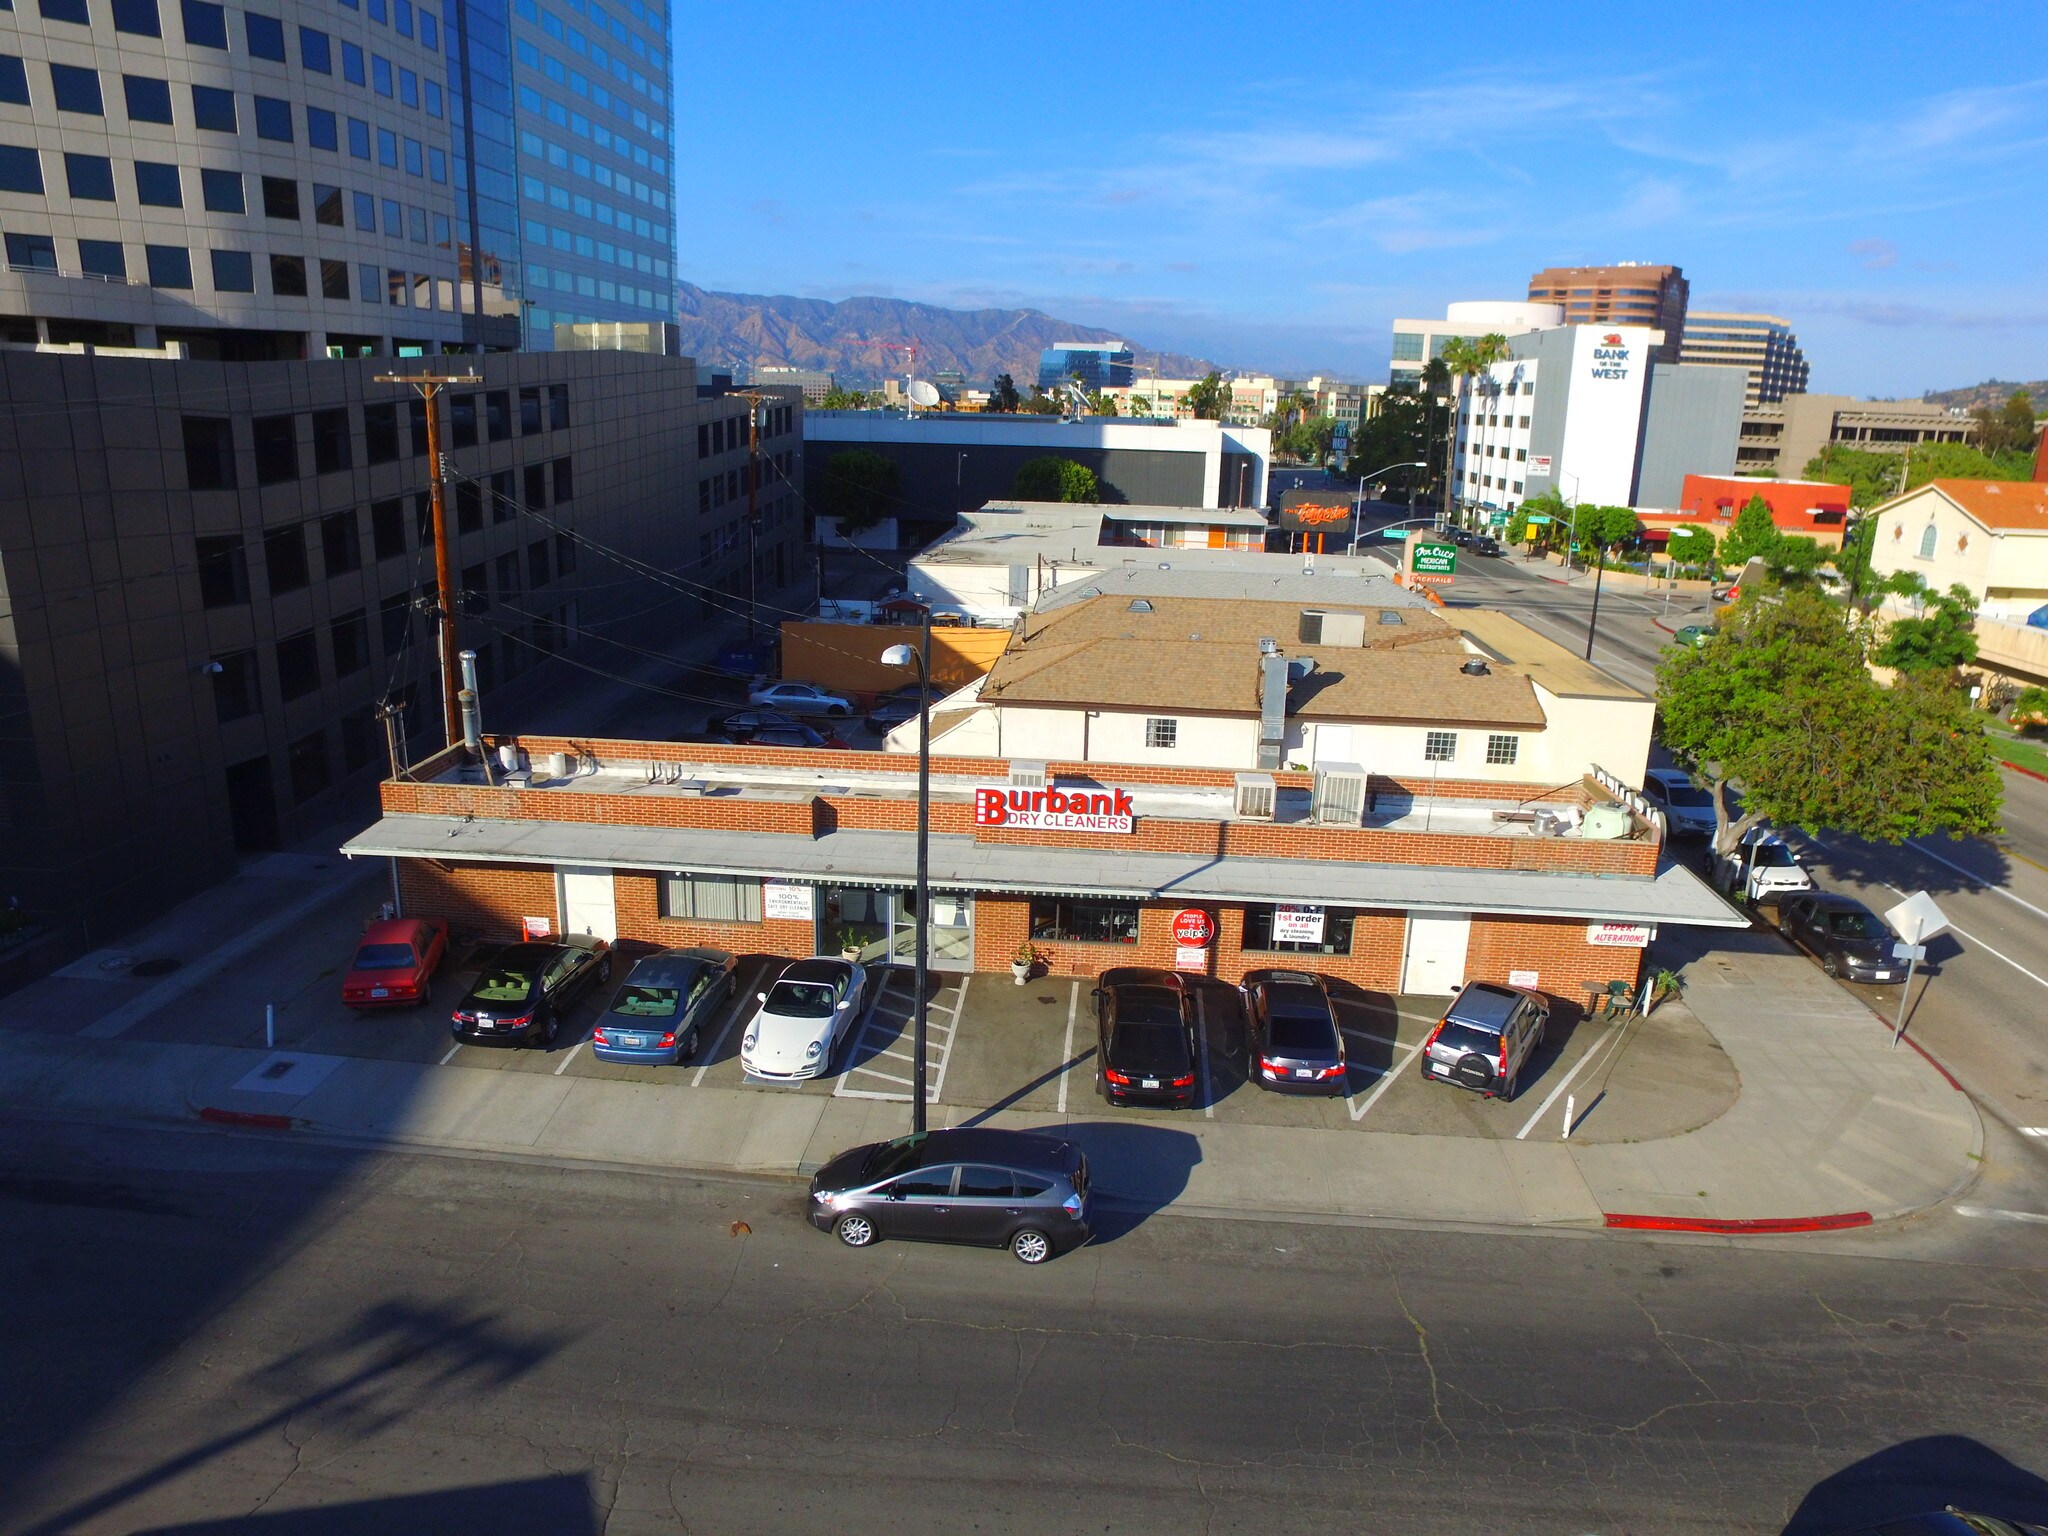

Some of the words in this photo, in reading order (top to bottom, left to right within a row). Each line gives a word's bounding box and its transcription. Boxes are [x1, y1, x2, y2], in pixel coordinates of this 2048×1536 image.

[1593, 349, 1629, 360] BANK
[1591, 368, 1628, 379] WEST
[1415, 547, 1431, 557] Don
[1432, 547, 1455, 559] Cuco
[976, 785, 1133, 825] Burbank
[1008, 812, 1040, 826] DRY
[1043, 814, 1128, 830] CLEANERS
[1279, 905, 1300, 913] 20%
[1603, 923, 1639, 932] EXPERT
[1177, 928, 1198, 939] yelp
[1594, 934, 1645, 942] ALTERATIONS
[1461, 1067, 1485, 1077] HONDA
